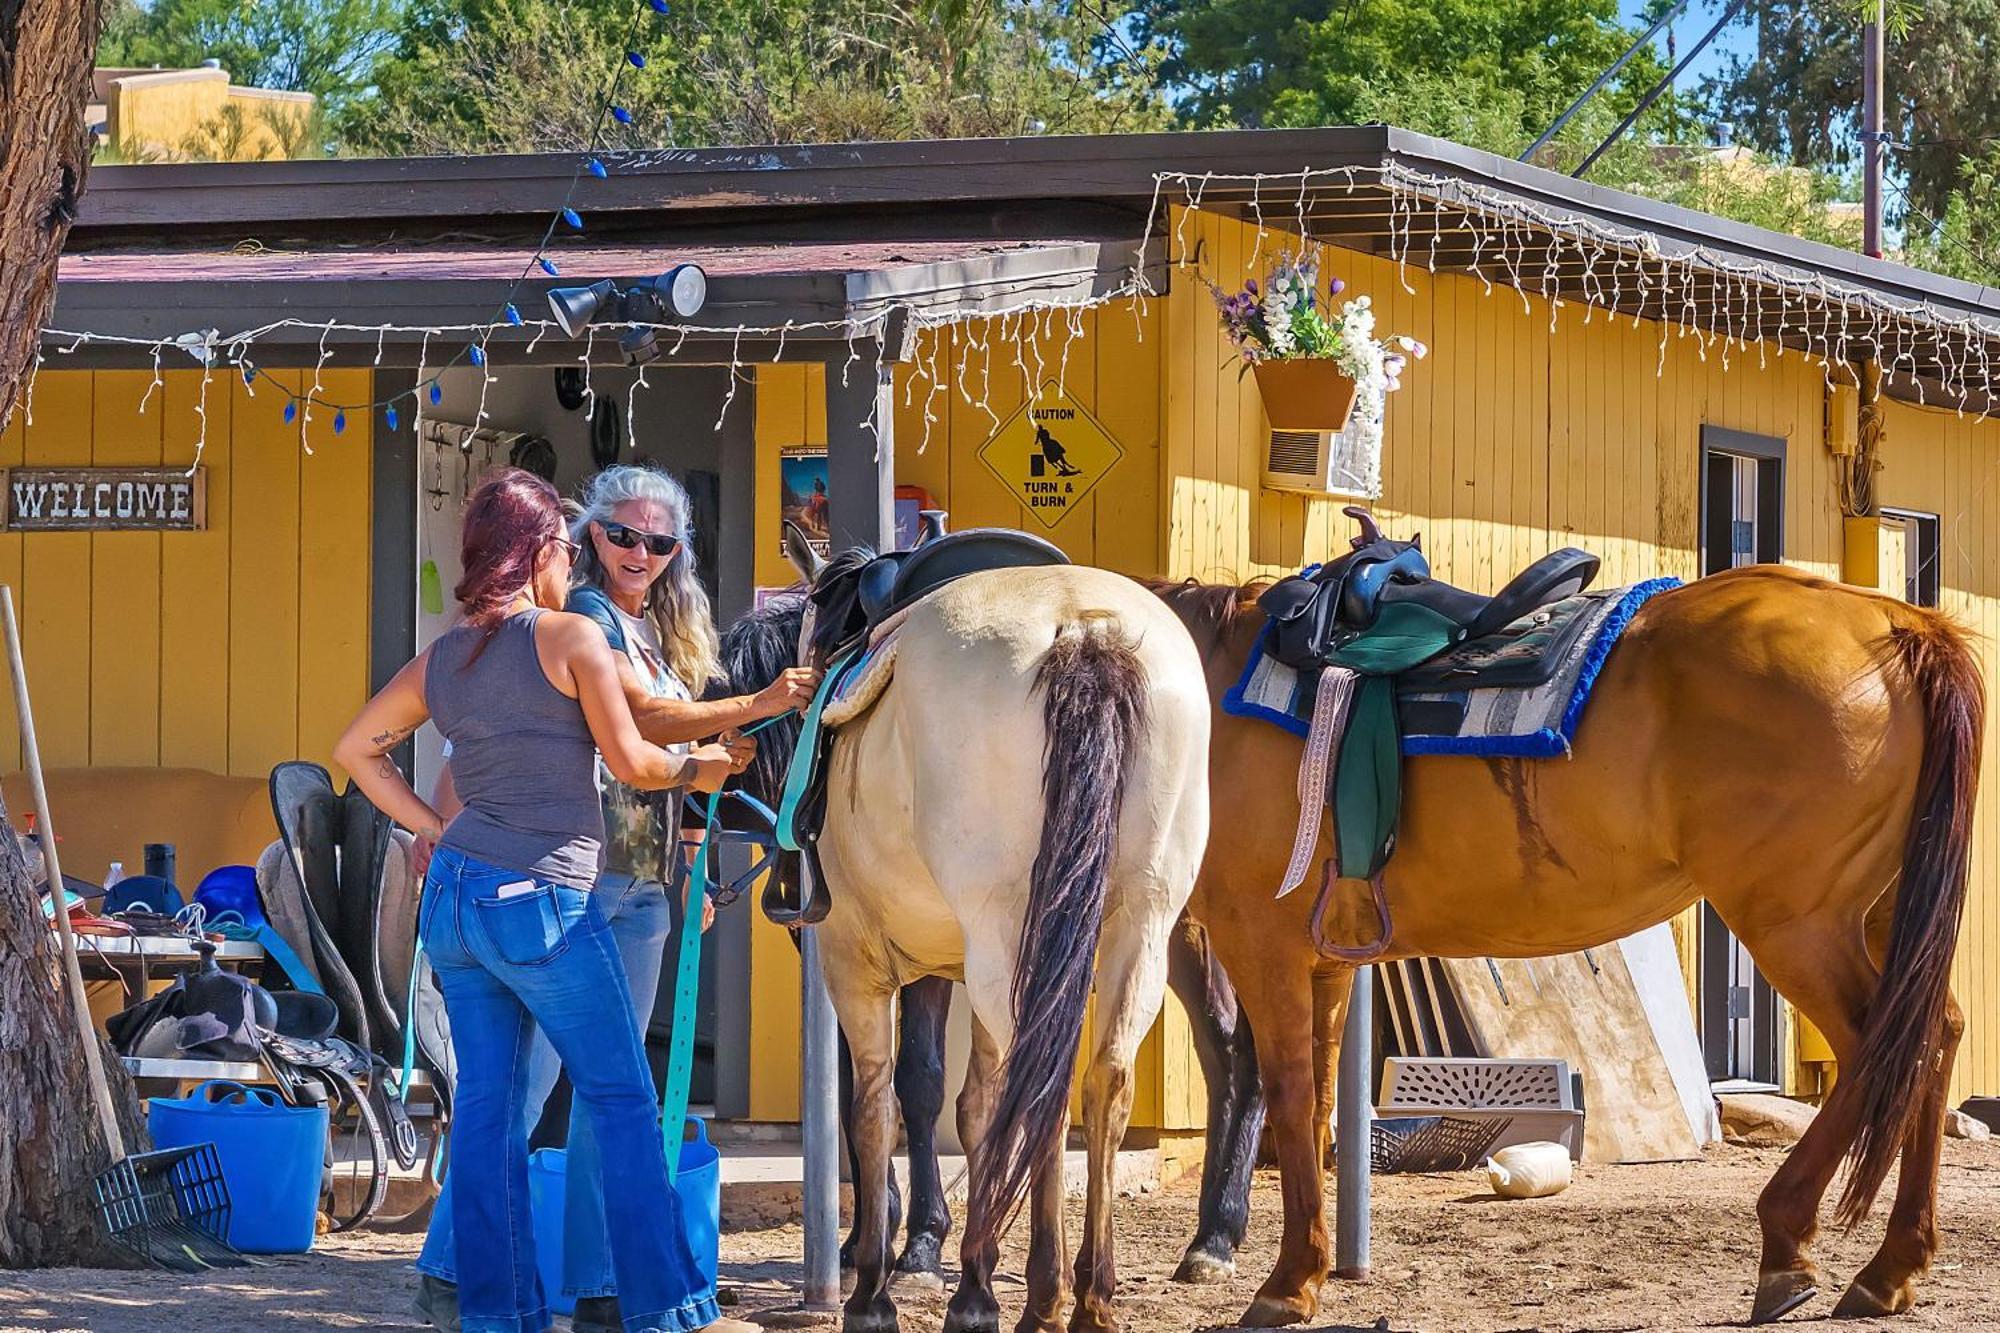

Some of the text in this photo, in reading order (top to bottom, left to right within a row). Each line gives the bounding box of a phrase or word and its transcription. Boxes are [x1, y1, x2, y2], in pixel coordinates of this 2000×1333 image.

[1024, 482, 1074, 493] TURN &
[13, 482, 189, 518] WELCOME
[1031, 496, 1066, 507] BURN
